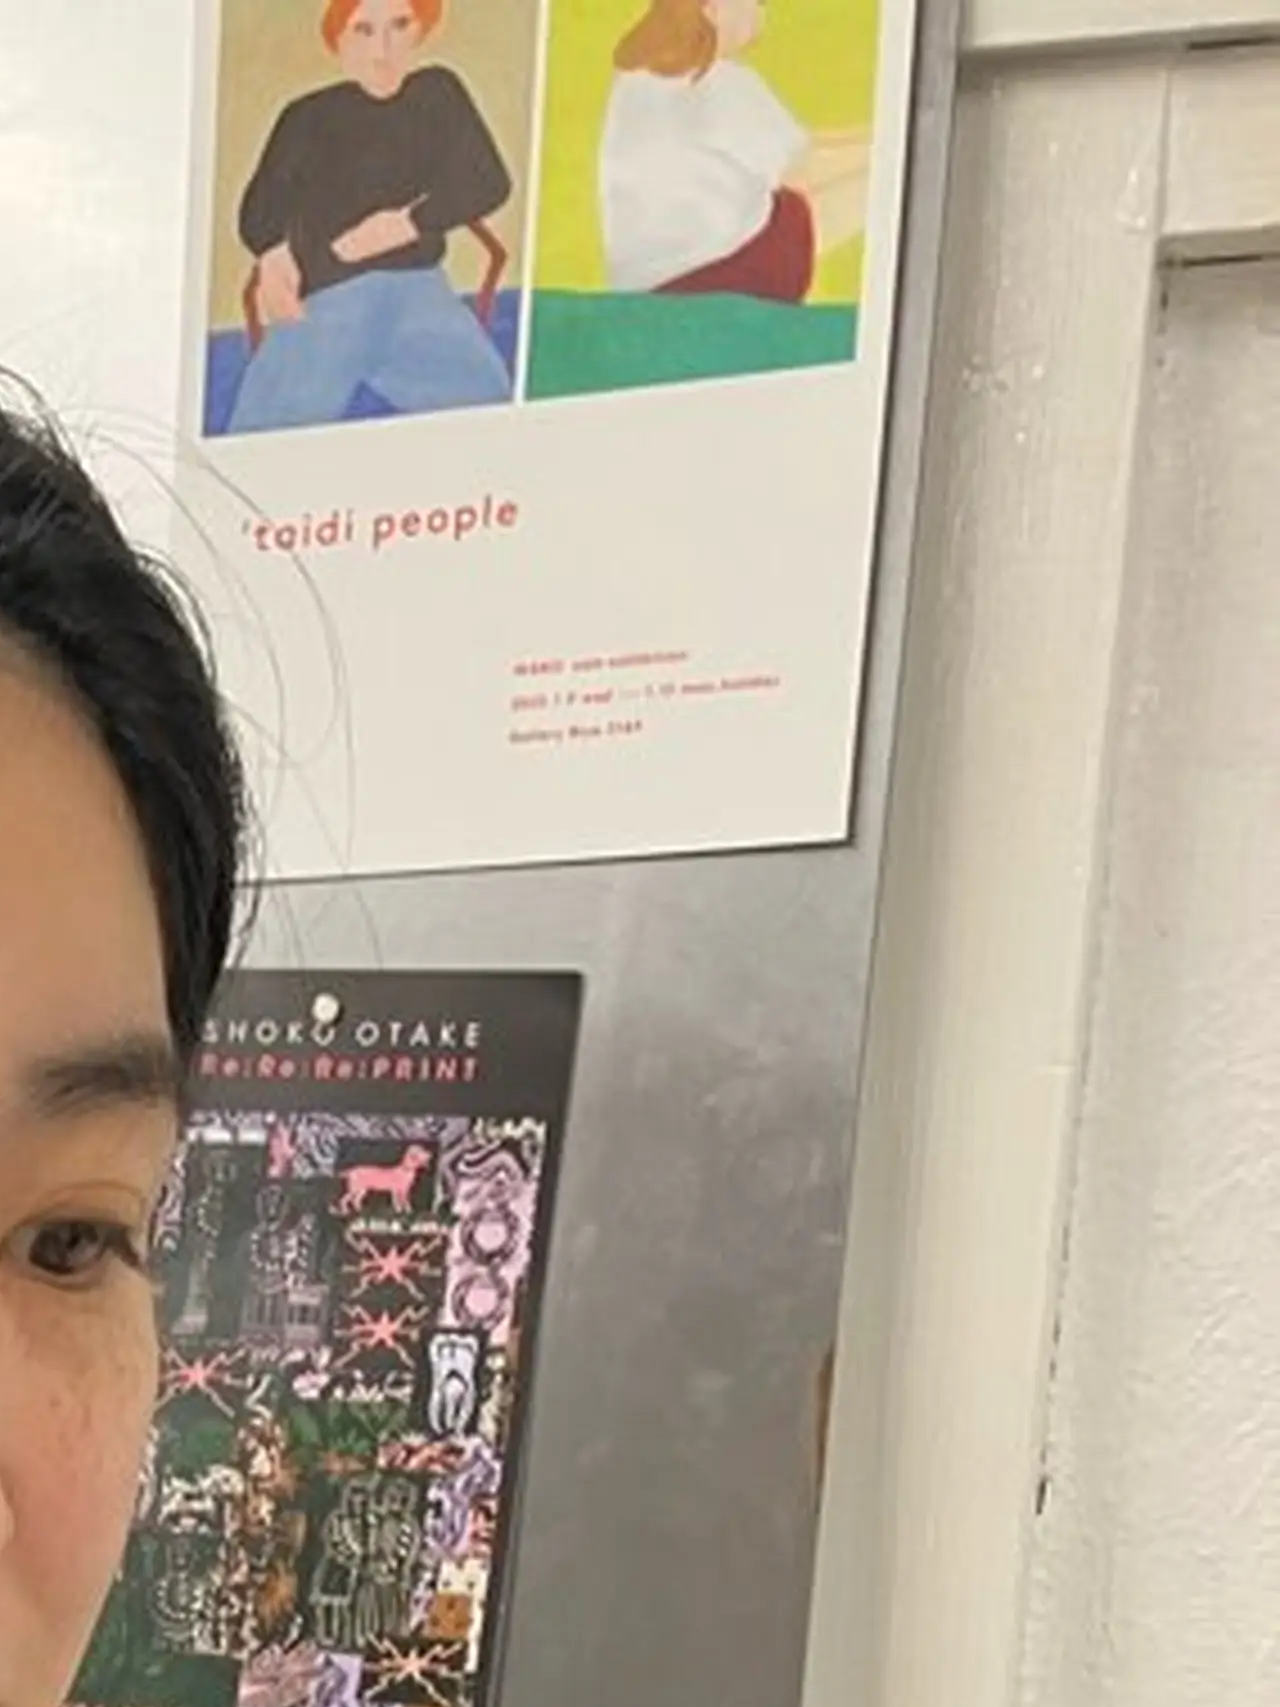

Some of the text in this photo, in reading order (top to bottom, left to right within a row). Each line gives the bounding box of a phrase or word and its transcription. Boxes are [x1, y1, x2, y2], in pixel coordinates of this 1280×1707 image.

[370, 491, 520, 556] people
[201, 1017, 481, 1048] SHOKO OTAKE
